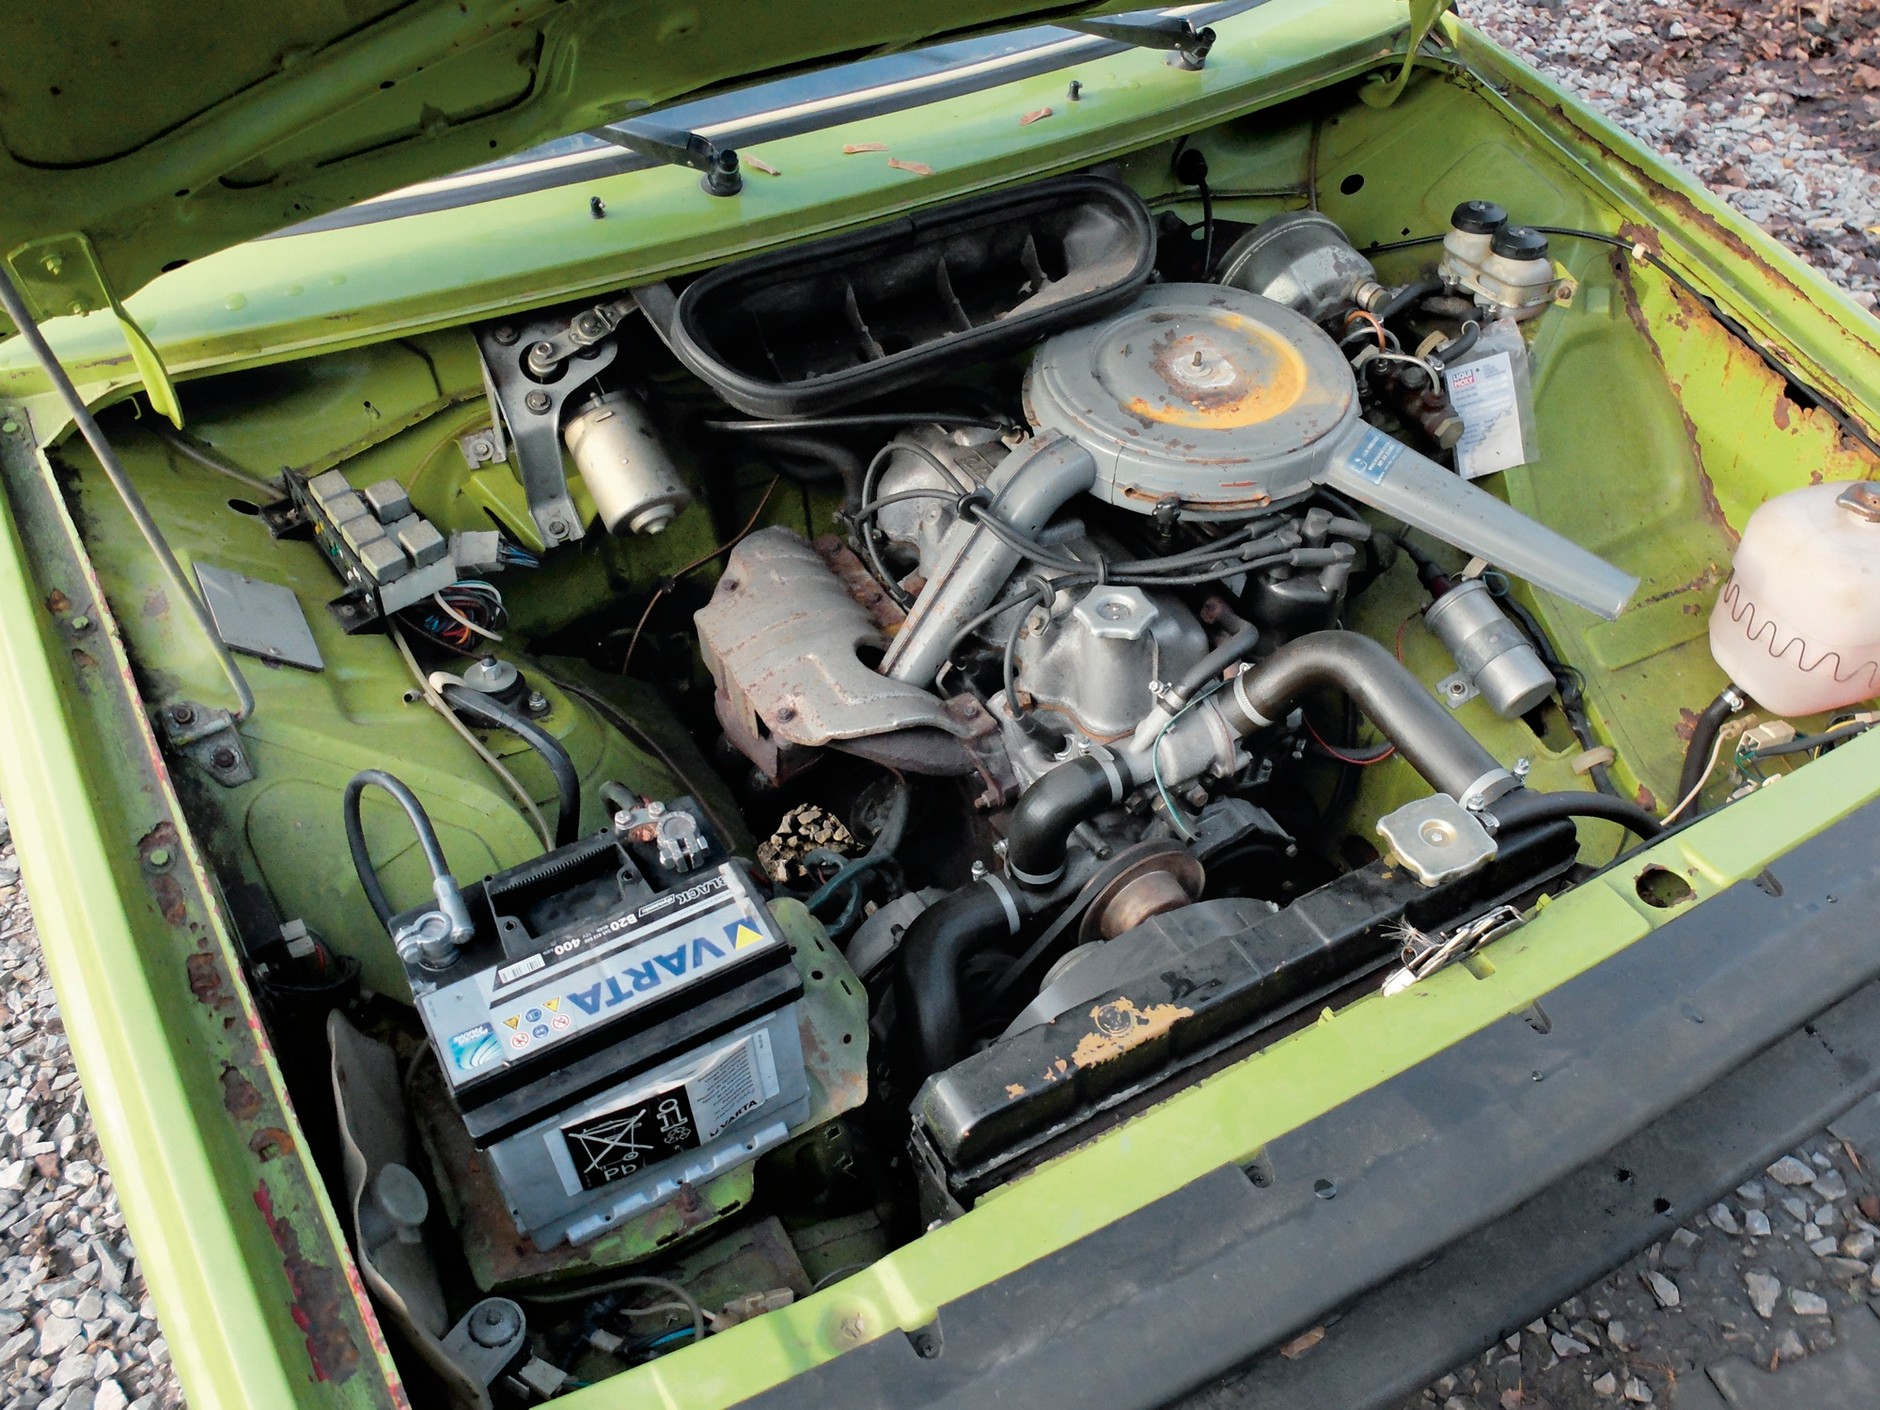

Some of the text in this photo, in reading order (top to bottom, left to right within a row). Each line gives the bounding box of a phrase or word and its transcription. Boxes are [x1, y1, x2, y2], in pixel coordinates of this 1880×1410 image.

[1453, 370, 1472, 381] LIQUI
[1454, 377, 1473, 388] MOLY
[676, 876, 727, 905] BLACK
[610, 913, 638, 931] B20
[554, 938, 581, 956] 400
[567, 937, 726, 1015] VARTA
[719, 1100, 758, 1133] VARTA
[604, 1163, 637, 1181] Pb
